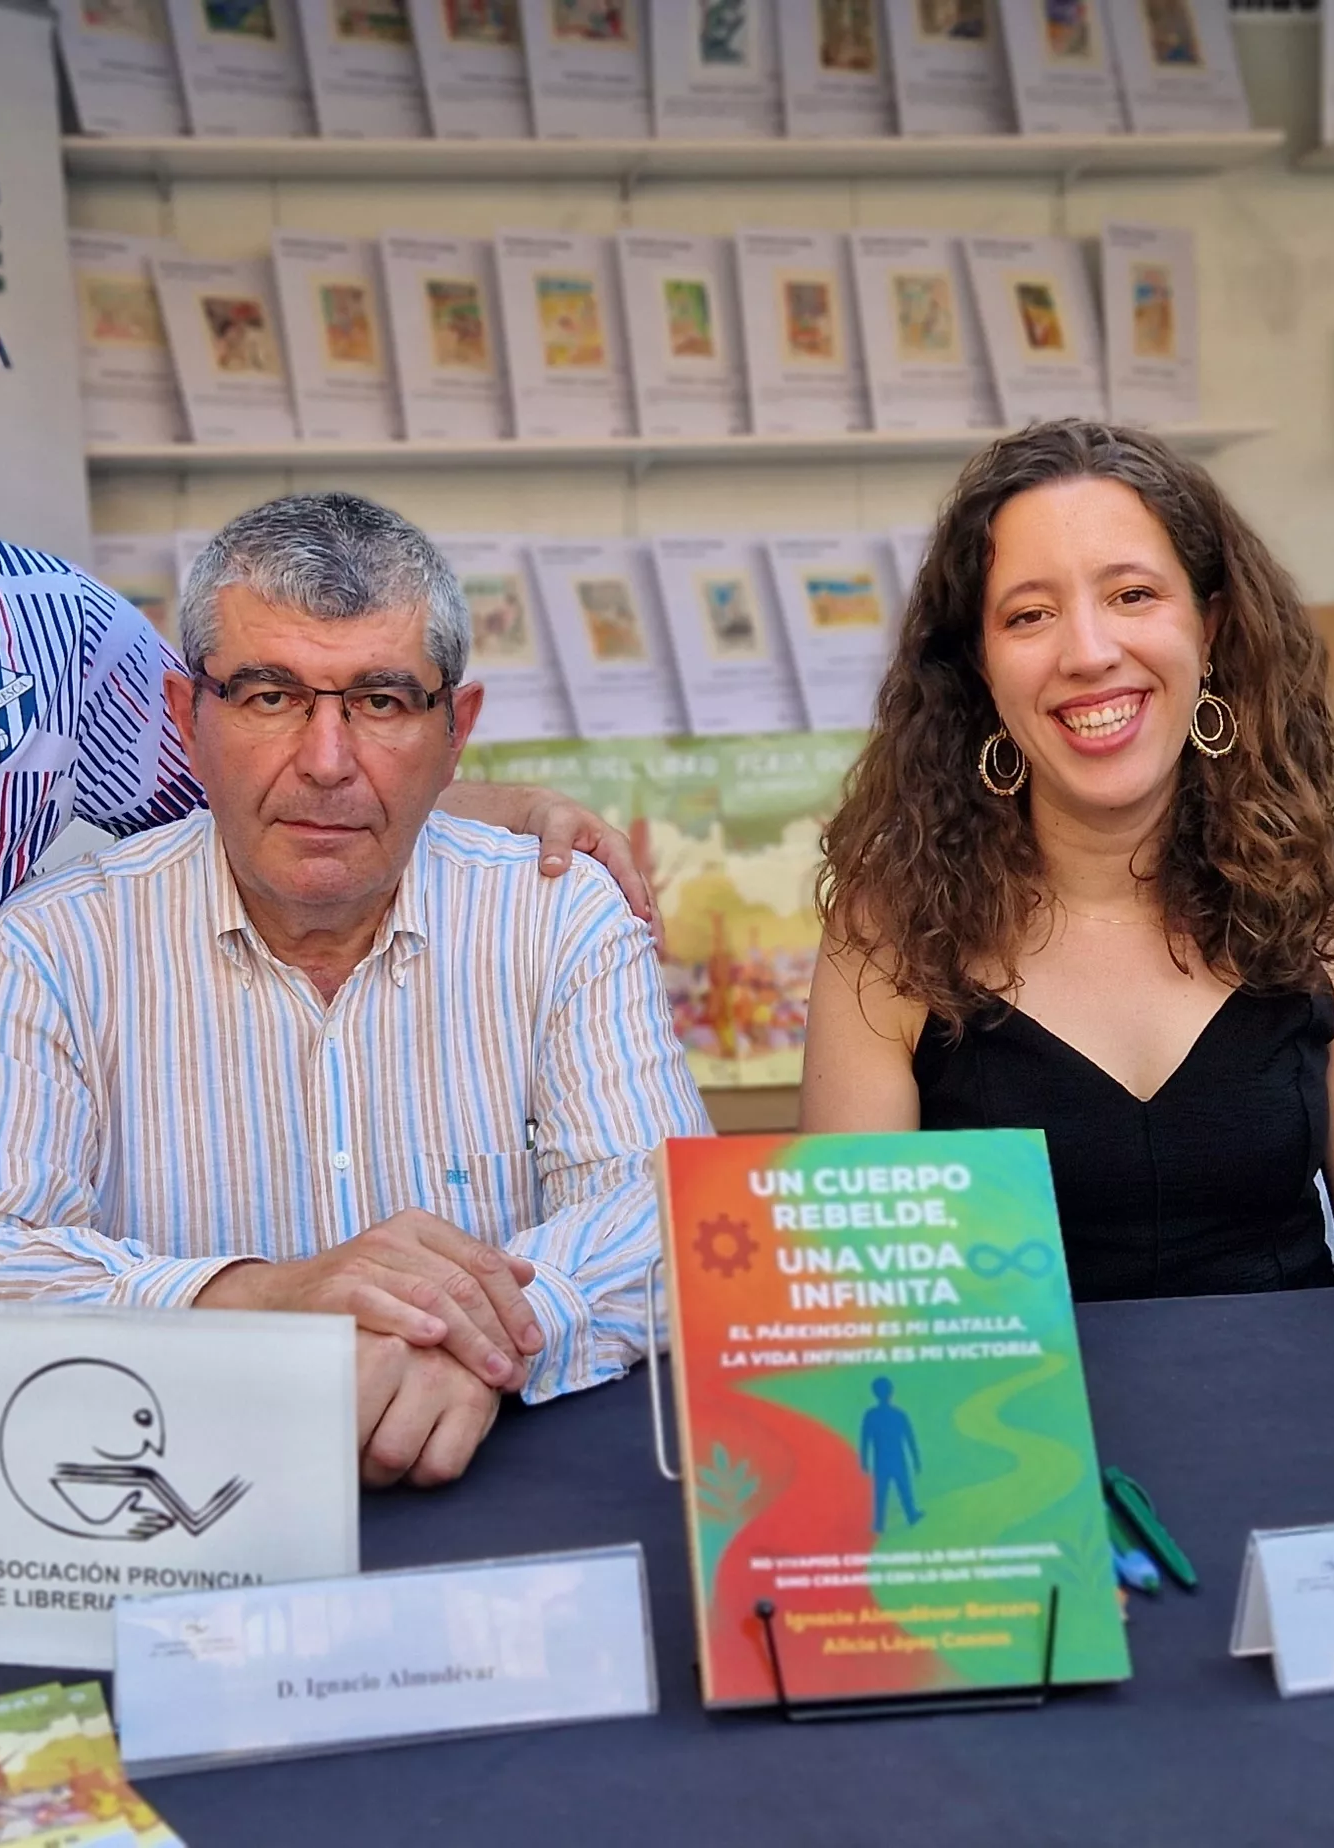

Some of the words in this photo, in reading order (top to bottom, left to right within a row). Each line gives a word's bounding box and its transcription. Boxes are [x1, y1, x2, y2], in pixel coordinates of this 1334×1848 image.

[748, 1169, 805, 1197] UN
[813, 1164, 971, 1195] CUERPO
[777, 1246, 864, 1275] UNA
[867, 1242, 966, 1272] VIDA
[790, 1278, 961, 1310] INFINITA
[729, 1325, 752, 1342] EL
[756, 1319, 873, 1340] PÁRKINSON
[877, 1322, 901, 1338] ES
[905, 1320, 929, 1336] MI
[721, 1351, 747, 1368] LA
[750, 1350, 798, 1366] VIDA
[802, 1347, 888, 1365] INFINITA
[892, 1346, 916, 1362] ES
[920, 1345, 944, 1361] MI
[947, 1340, 1044, 1361] VICTORIA
[277, 1679, 299, 1699] D.
[307, 1674, 381, 1700] Ignacio
[387, 1664, 497, 1690] Almudévar
